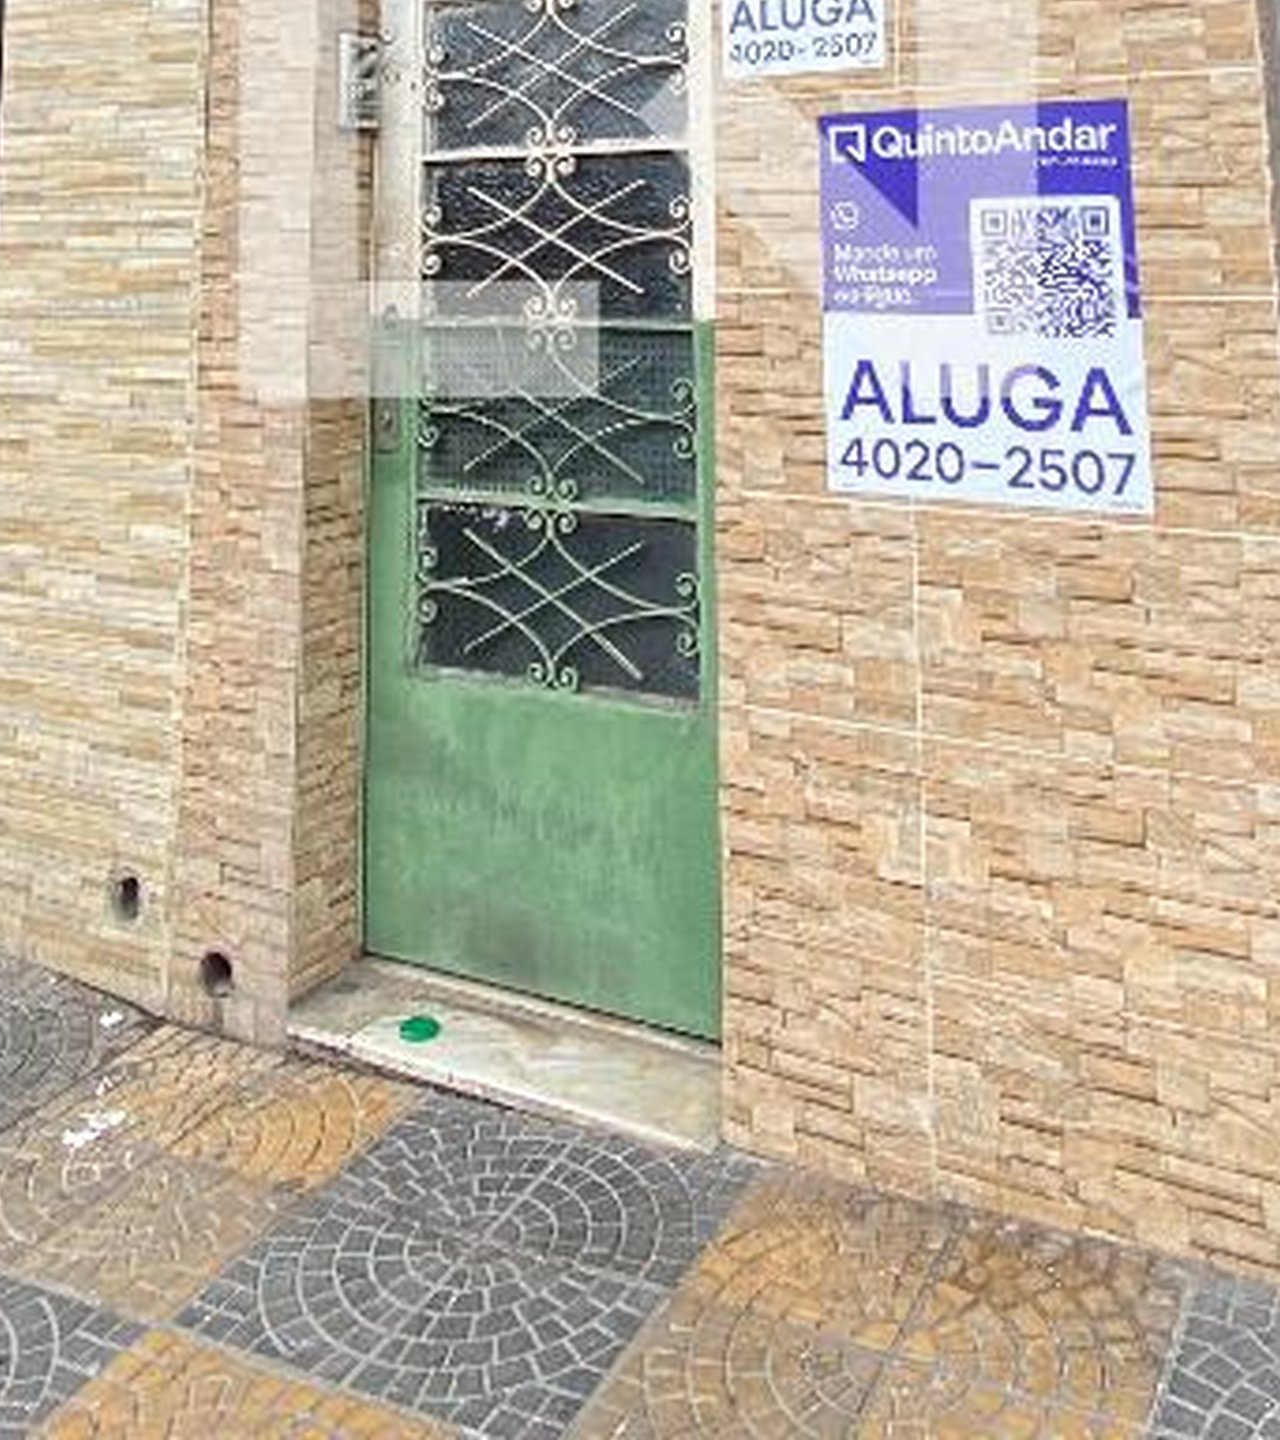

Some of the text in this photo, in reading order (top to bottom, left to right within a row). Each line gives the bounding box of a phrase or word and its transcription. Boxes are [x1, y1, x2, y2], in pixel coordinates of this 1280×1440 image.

[871, 116, 1117, 160] QuintoAndar
[840, 359, 1133, 436] ALUGA
[840, 437, 1137, 496] 4020-2507
